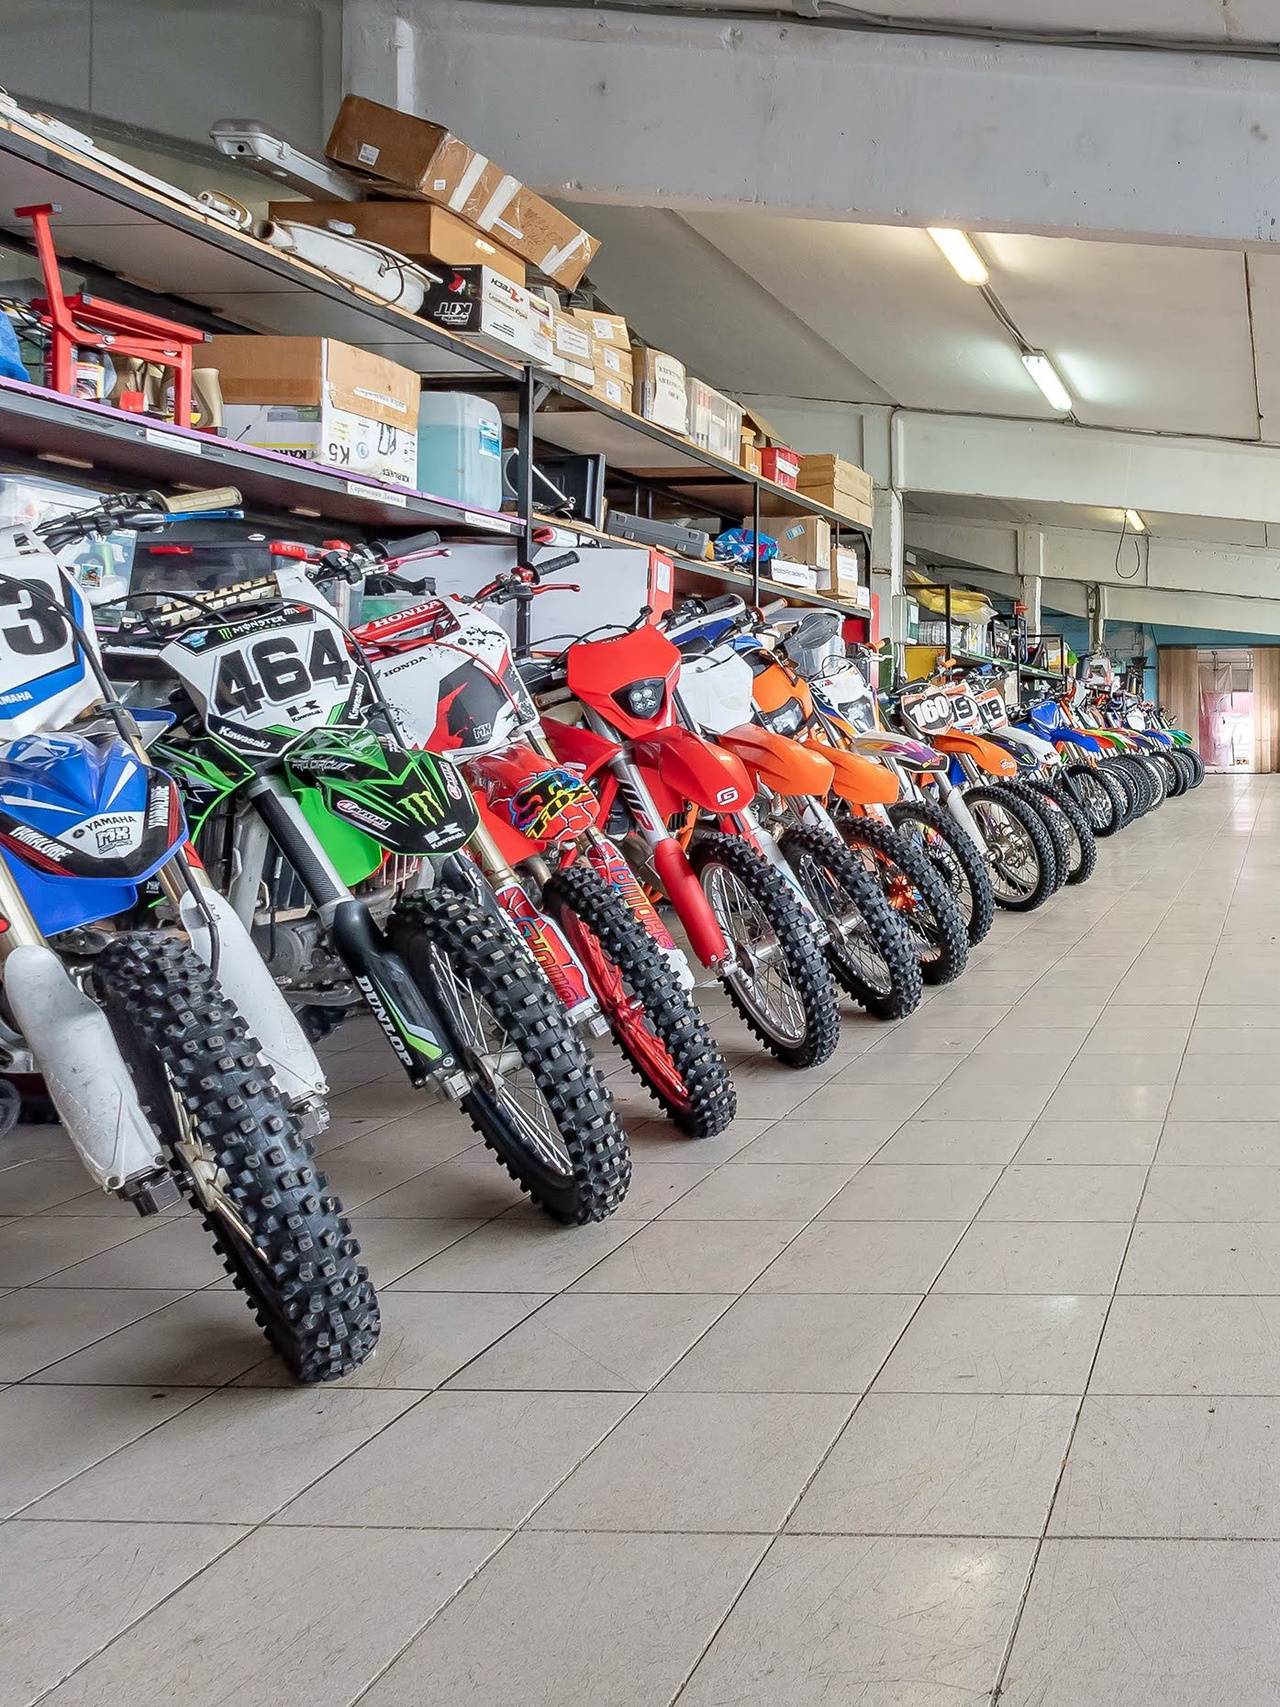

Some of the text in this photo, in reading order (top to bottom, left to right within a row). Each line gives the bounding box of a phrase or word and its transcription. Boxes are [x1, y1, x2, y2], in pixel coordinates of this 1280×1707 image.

[434, 302, 472, 317] KIT
[329, 442, 350, 464] K5
[0, 578, 68, 656] 3
[160, 585, 277, 627] ENTHAL
[373, 600, 441, 629] HONDA
[231, 615, 287, 634] MONSTER
[214, 629, 352, 716] 464
[383, 655, 428, 678] HONDA
[348, 682, 364, 720] Kawasaki
[908, 695, 950, 728] 160
[290, 709, 323, 723] Kawasaki
[218, 724, 272, 750] Kawasaki
[472, 722, 494, 742] MX
[85, 815, 137, 832] YAMAHA
[526, 784, 591, 840] FOX
[9, 825, 74, 862] YAMALUBE
[430, 831, 467, 850] Kawasaki
[355, 974, 413, 1067] DUNLOP
